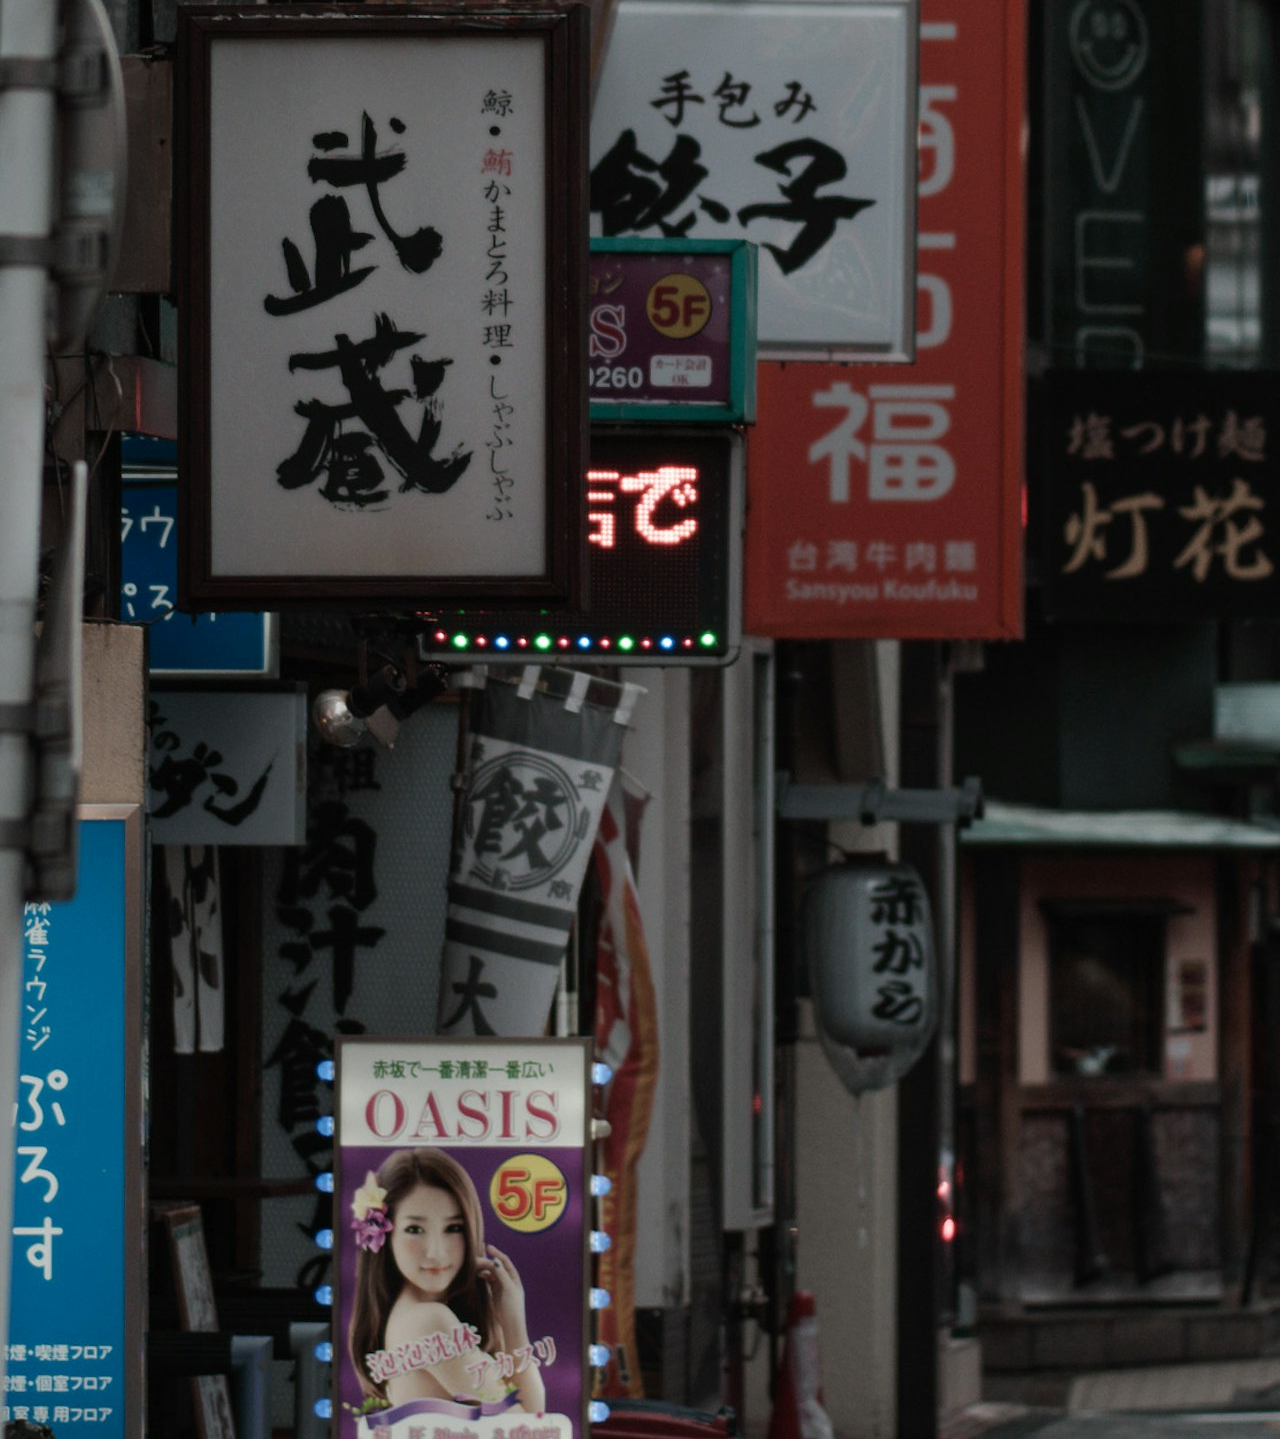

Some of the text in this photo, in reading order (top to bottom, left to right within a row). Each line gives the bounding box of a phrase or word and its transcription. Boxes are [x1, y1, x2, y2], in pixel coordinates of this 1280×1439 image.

[650, 69, 818, 129] 手包み
[589, 128, 878, 276] 餃子
[263, 108, 475, 511] 武蔵
[651, 285, 708, 328] 5F
[1060, 476, 1276, 584] 灯花
[785, 577, 979, 605] Sansyou Koufuku
[870, 875, 924, 1025] 赤から
[372, 1059, 555, 1080] 赤坂で一番清潔一番広い
[364, 1088, 561, 1141] OASIS
[11, 1066, 70, 1283] ぷろす
[495, 1168, 565, 1221] 5F
[465, 1334, 558, 1390] アカスリ
